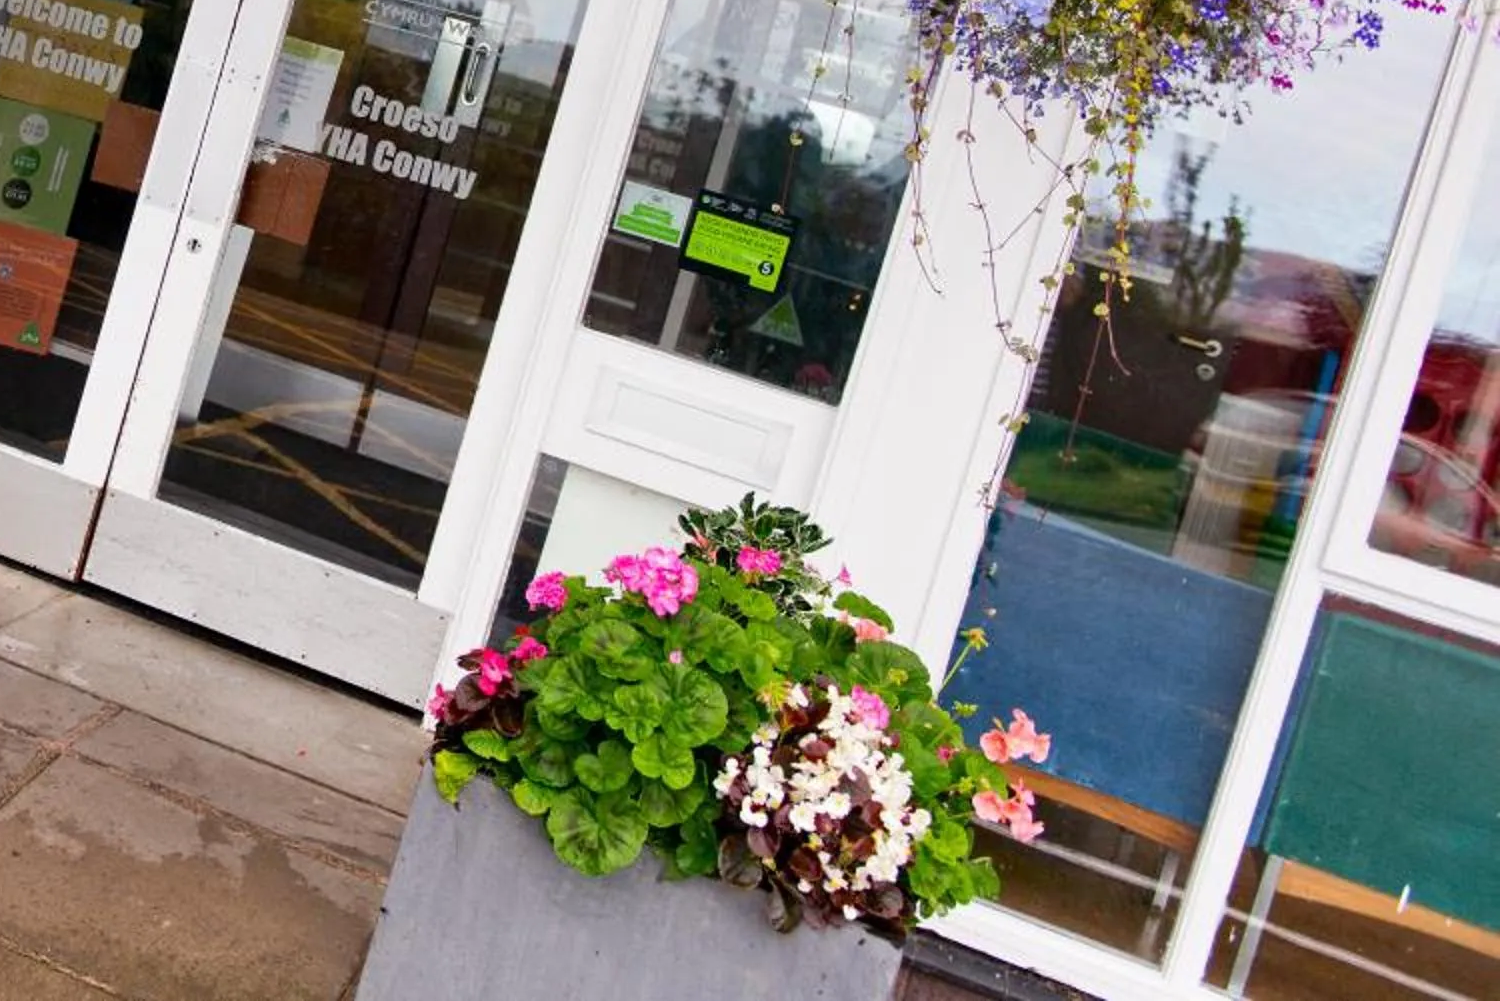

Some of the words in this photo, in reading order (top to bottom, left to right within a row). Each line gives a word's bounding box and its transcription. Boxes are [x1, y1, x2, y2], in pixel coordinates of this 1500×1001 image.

[113, 17, 143, 49] to
[32, 36, 126, 94] Conwy
[351, 84, 459, 144] Croeso
[315, 120, 369, 166] YHA
[372, 140, 478, 200] Conwy
[761, 262, 771, 275] 5
